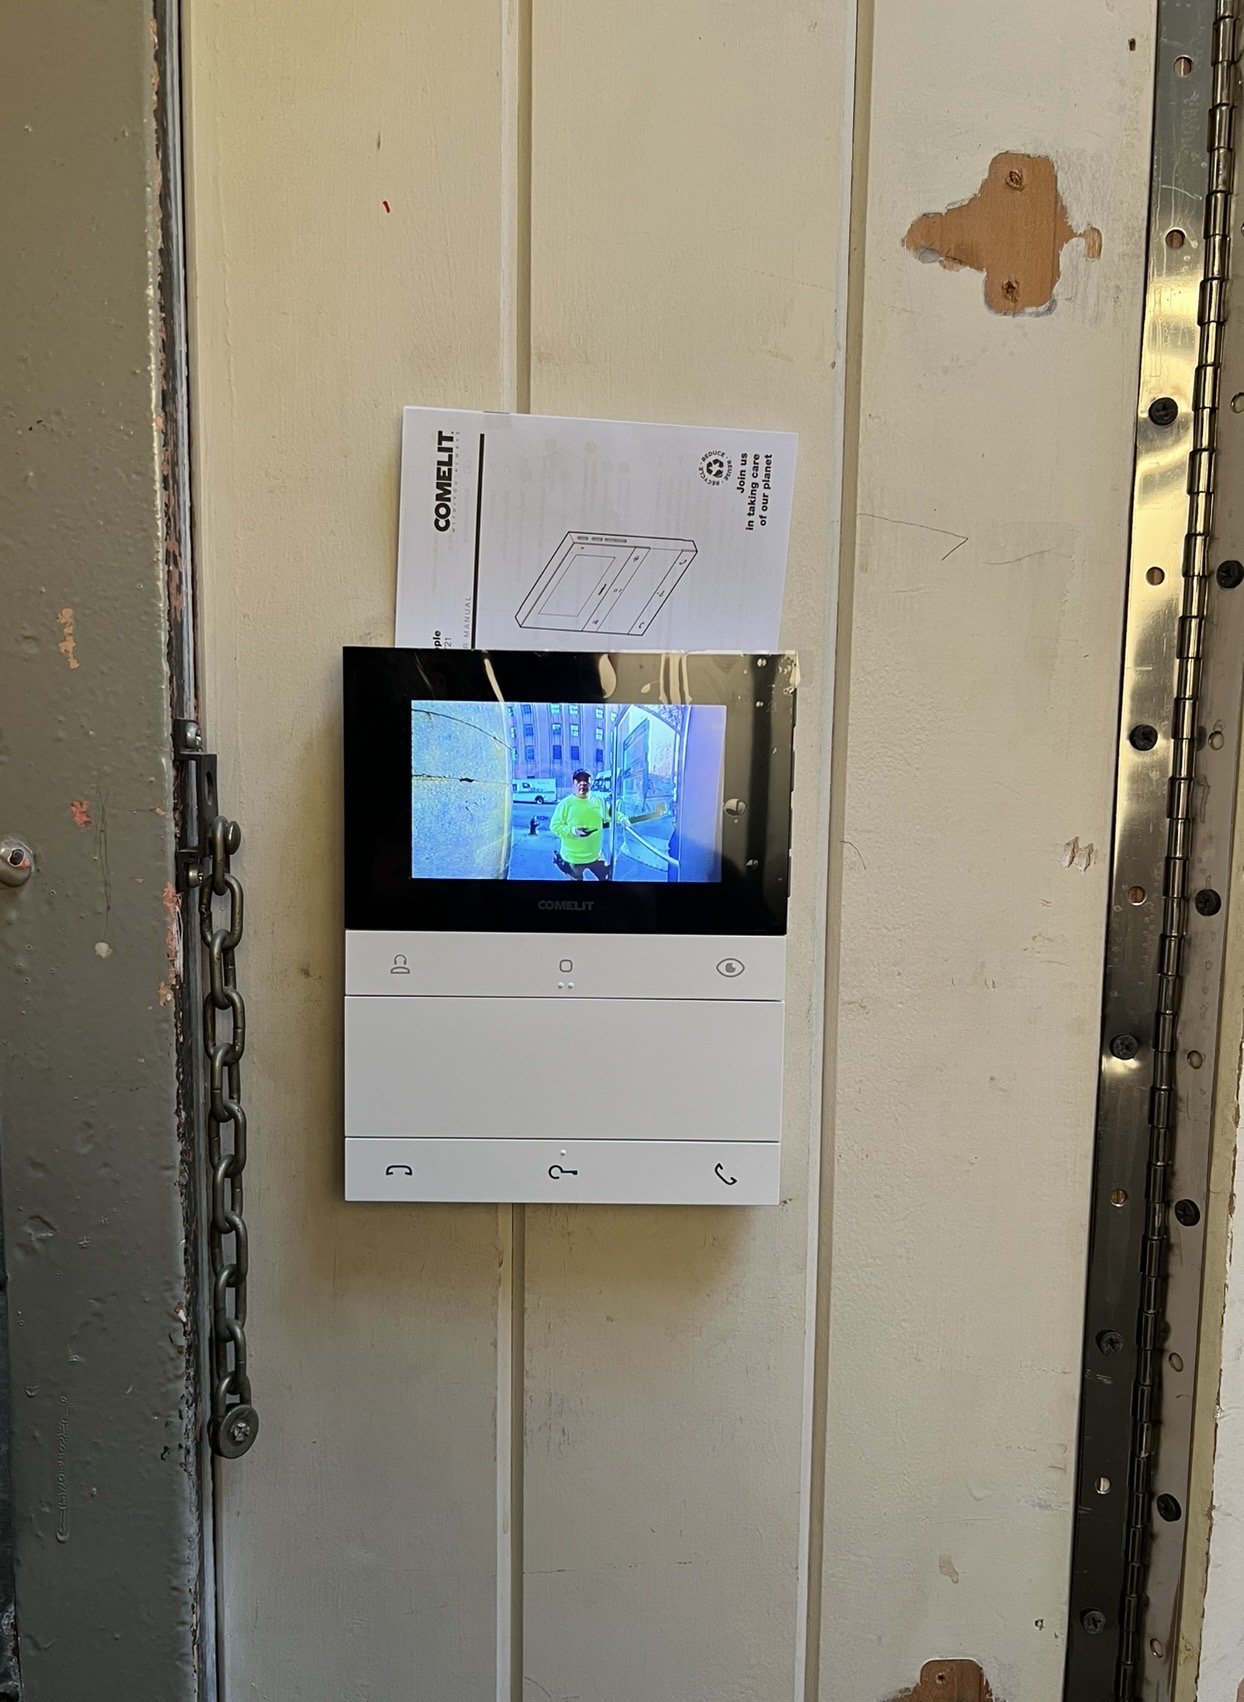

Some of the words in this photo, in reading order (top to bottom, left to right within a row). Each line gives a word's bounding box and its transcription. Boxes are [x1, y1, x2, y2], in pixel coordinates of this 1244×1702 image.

[701, 450, 726, 462] REDUCE
[740, 452, 748, 466] us
[724, 460, 733, 481] REUSE
[751, 453, 760, 479] care
[762, 454, 773, 490] planet
[698, 467, 720, 486] RECYCLE
[736, 469, 747, 494] Join
[747, 482, 760, 517] taking
[761, 493, 769, 512] our
[745, 520, 755, 531] in
[759, 514, 767, 527] of
[463, 597, 472, 638] MANUAL
[537, 900, 595, 911] COMELIT
